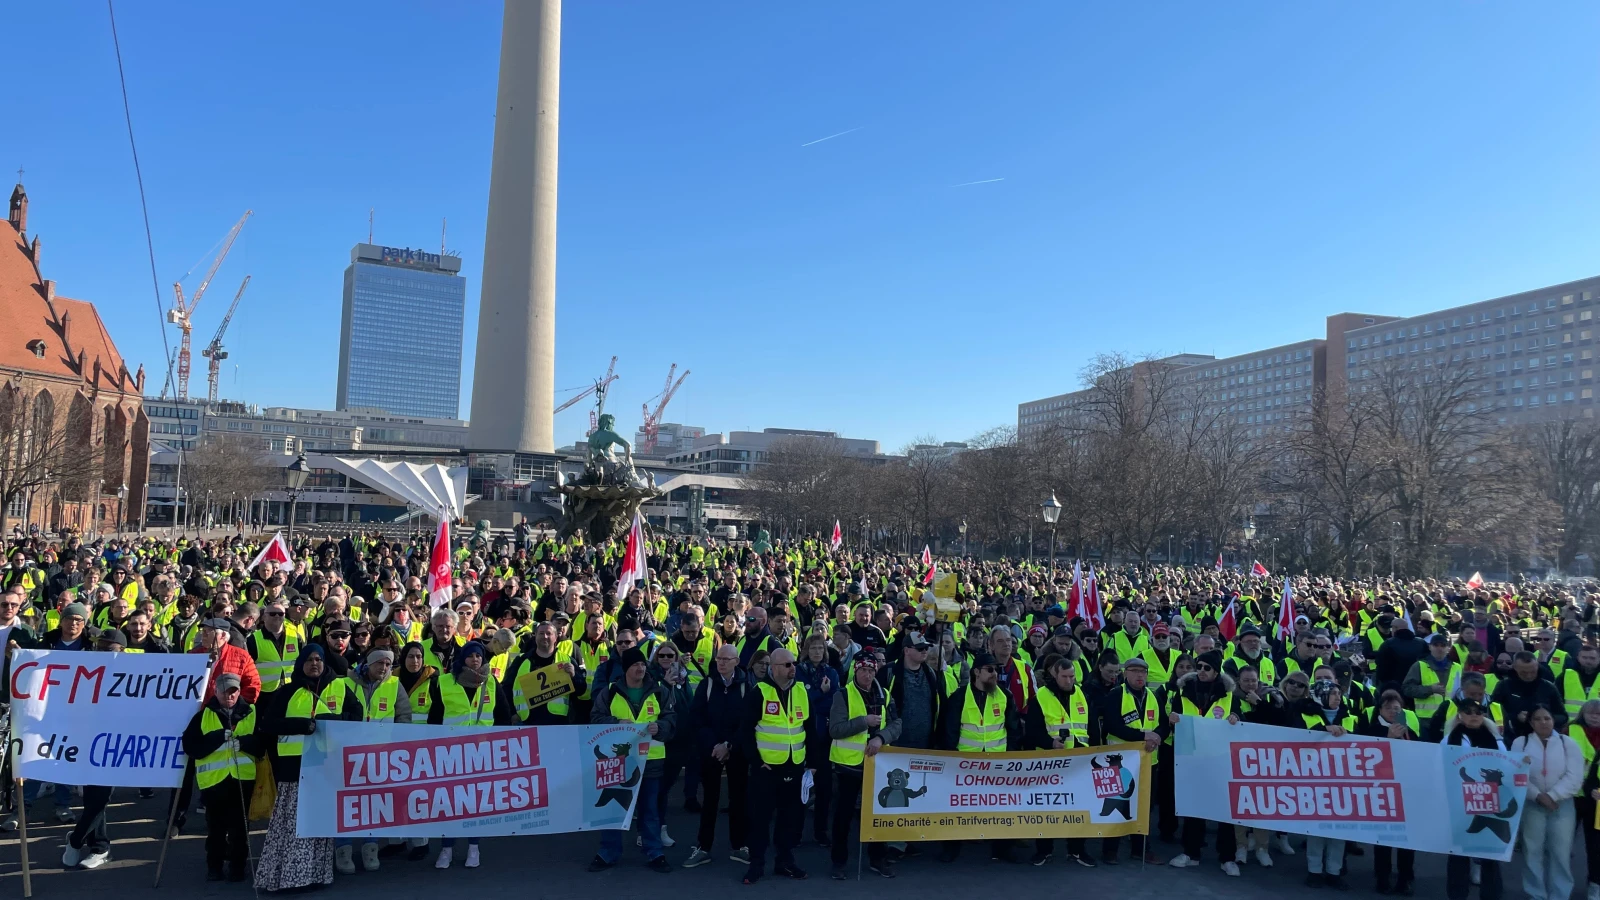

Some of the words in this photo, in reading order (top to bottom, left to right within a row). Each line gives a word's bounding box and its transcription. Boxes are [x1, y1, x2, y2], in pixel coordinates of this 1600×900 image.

[382, 246, 415, 259] park
[418, 249, 440, 263] inn
[11, 661, 106, 704] CFM
[107, 668, 204, 700] zurück
[536, 671, 550, 691] 2
[37, 734, 79, 762] die
[1239, 742, 1383, 777] CHARITÉ?
[348, 736, 531, 785] ZUSAMMEN
[959, 760, 991, 771] CFM
[1006, 761, 1022, 772] 20
[1026, 759, 1071, 772] JAHRE
[955, 774, 1064, 787] LOHNDUMPING:
[343, 792, 395, 827] EIN
[408, 775, 540, 820] GANZES!
[950, 793, 1022, 806] BEENDEN!
[1026, 793, 1074, 806] JETZT!
[1237, 781, 1397, 817] AUSBEUTÉ!
[873, 818, 894, 828] Eine
[896, 817, 931, 828] Charité
[940, 816, 954, 826] ein
[956, 815, 1015, 827] Tarifvertrag:
[1017, 815, 1043, 824] TVöD
[1046, 814, 1060, 824] für
[1062, 814, 1085, 824] Alle!
